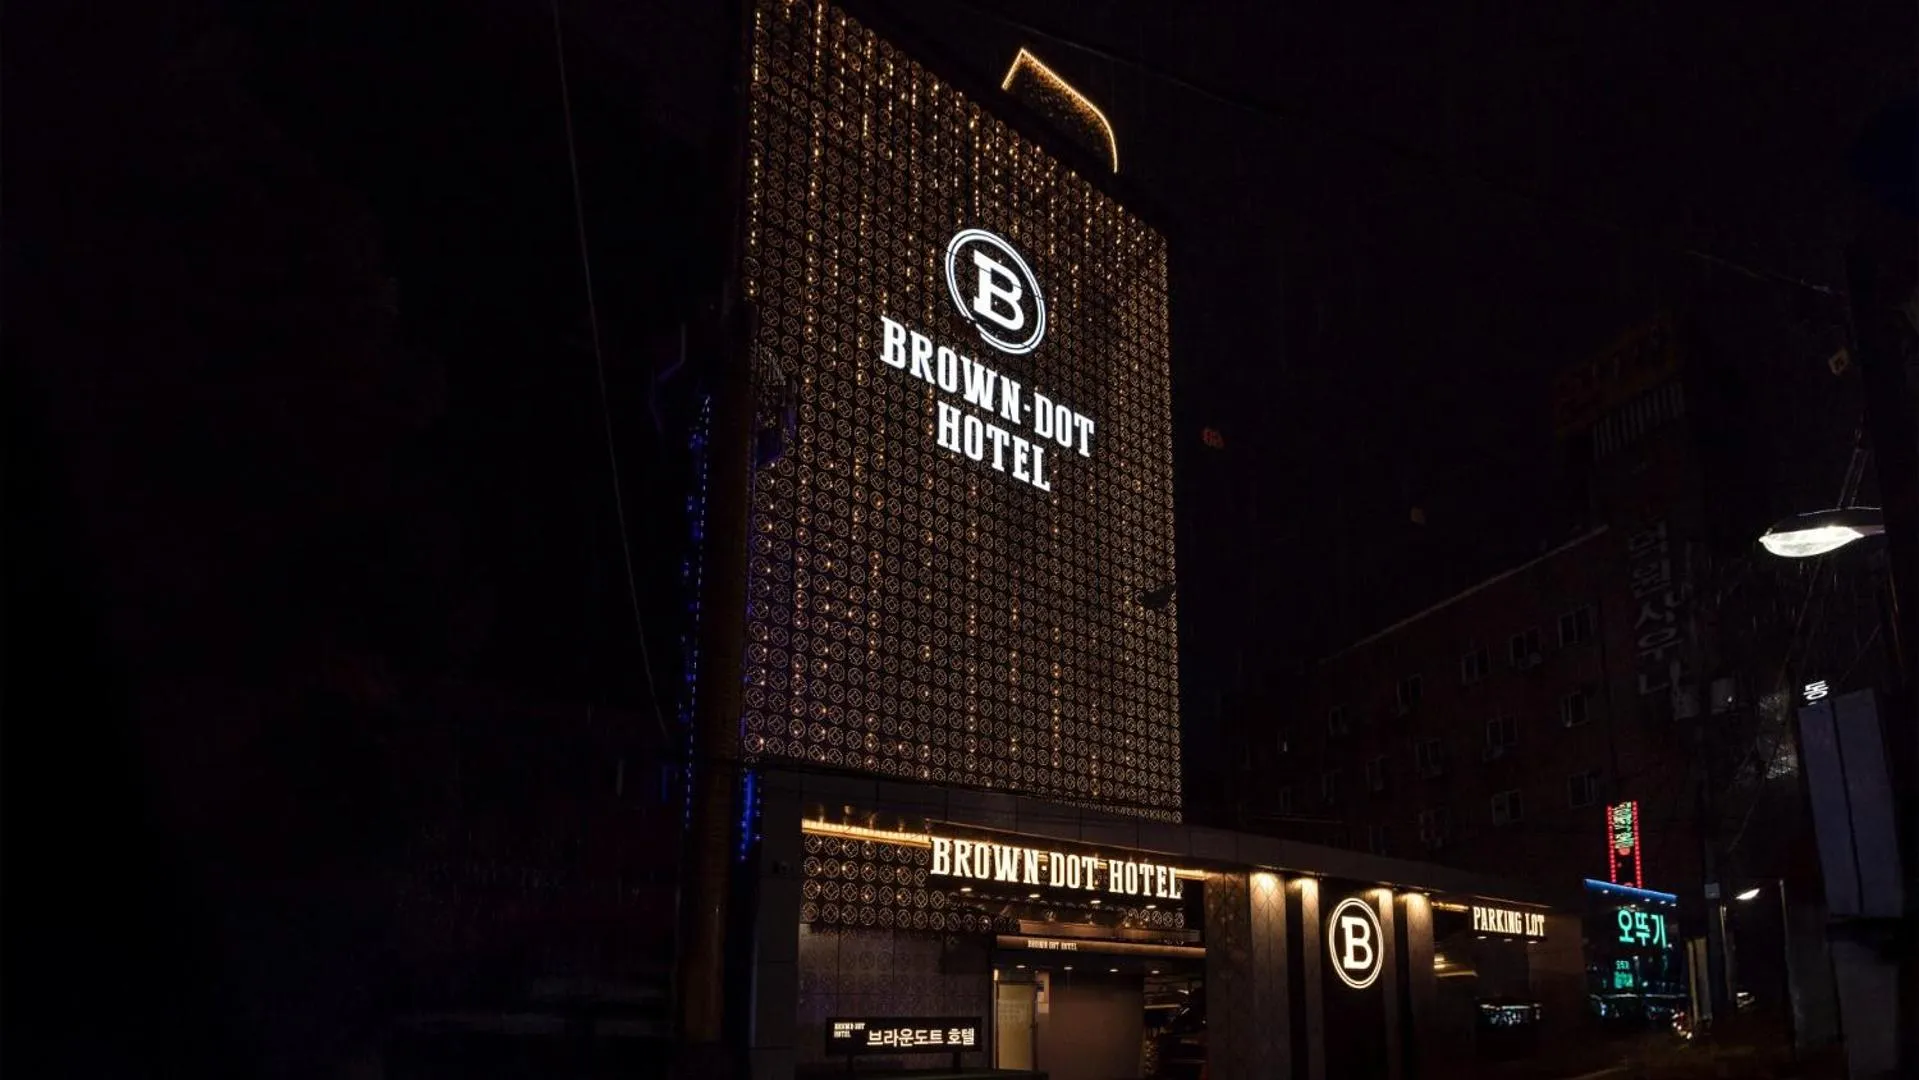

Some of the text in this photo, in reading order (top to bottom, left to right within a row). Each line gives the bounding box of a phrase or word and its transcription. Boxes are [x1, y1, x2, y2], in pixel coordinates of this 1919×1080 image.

[974, 249, 1024, 331] B
[937, 400, 1051, 492] HOTEL
[1109, 859, 1182, 899] HOTEL
[1473, 906, 1545, 937] PARKING LOT
[1618, 909, 1666, 949] 오뚜기
[1341, 915, 1373, 969] B
[867, 1027, 975, 1047] 브라운도트 호텔
